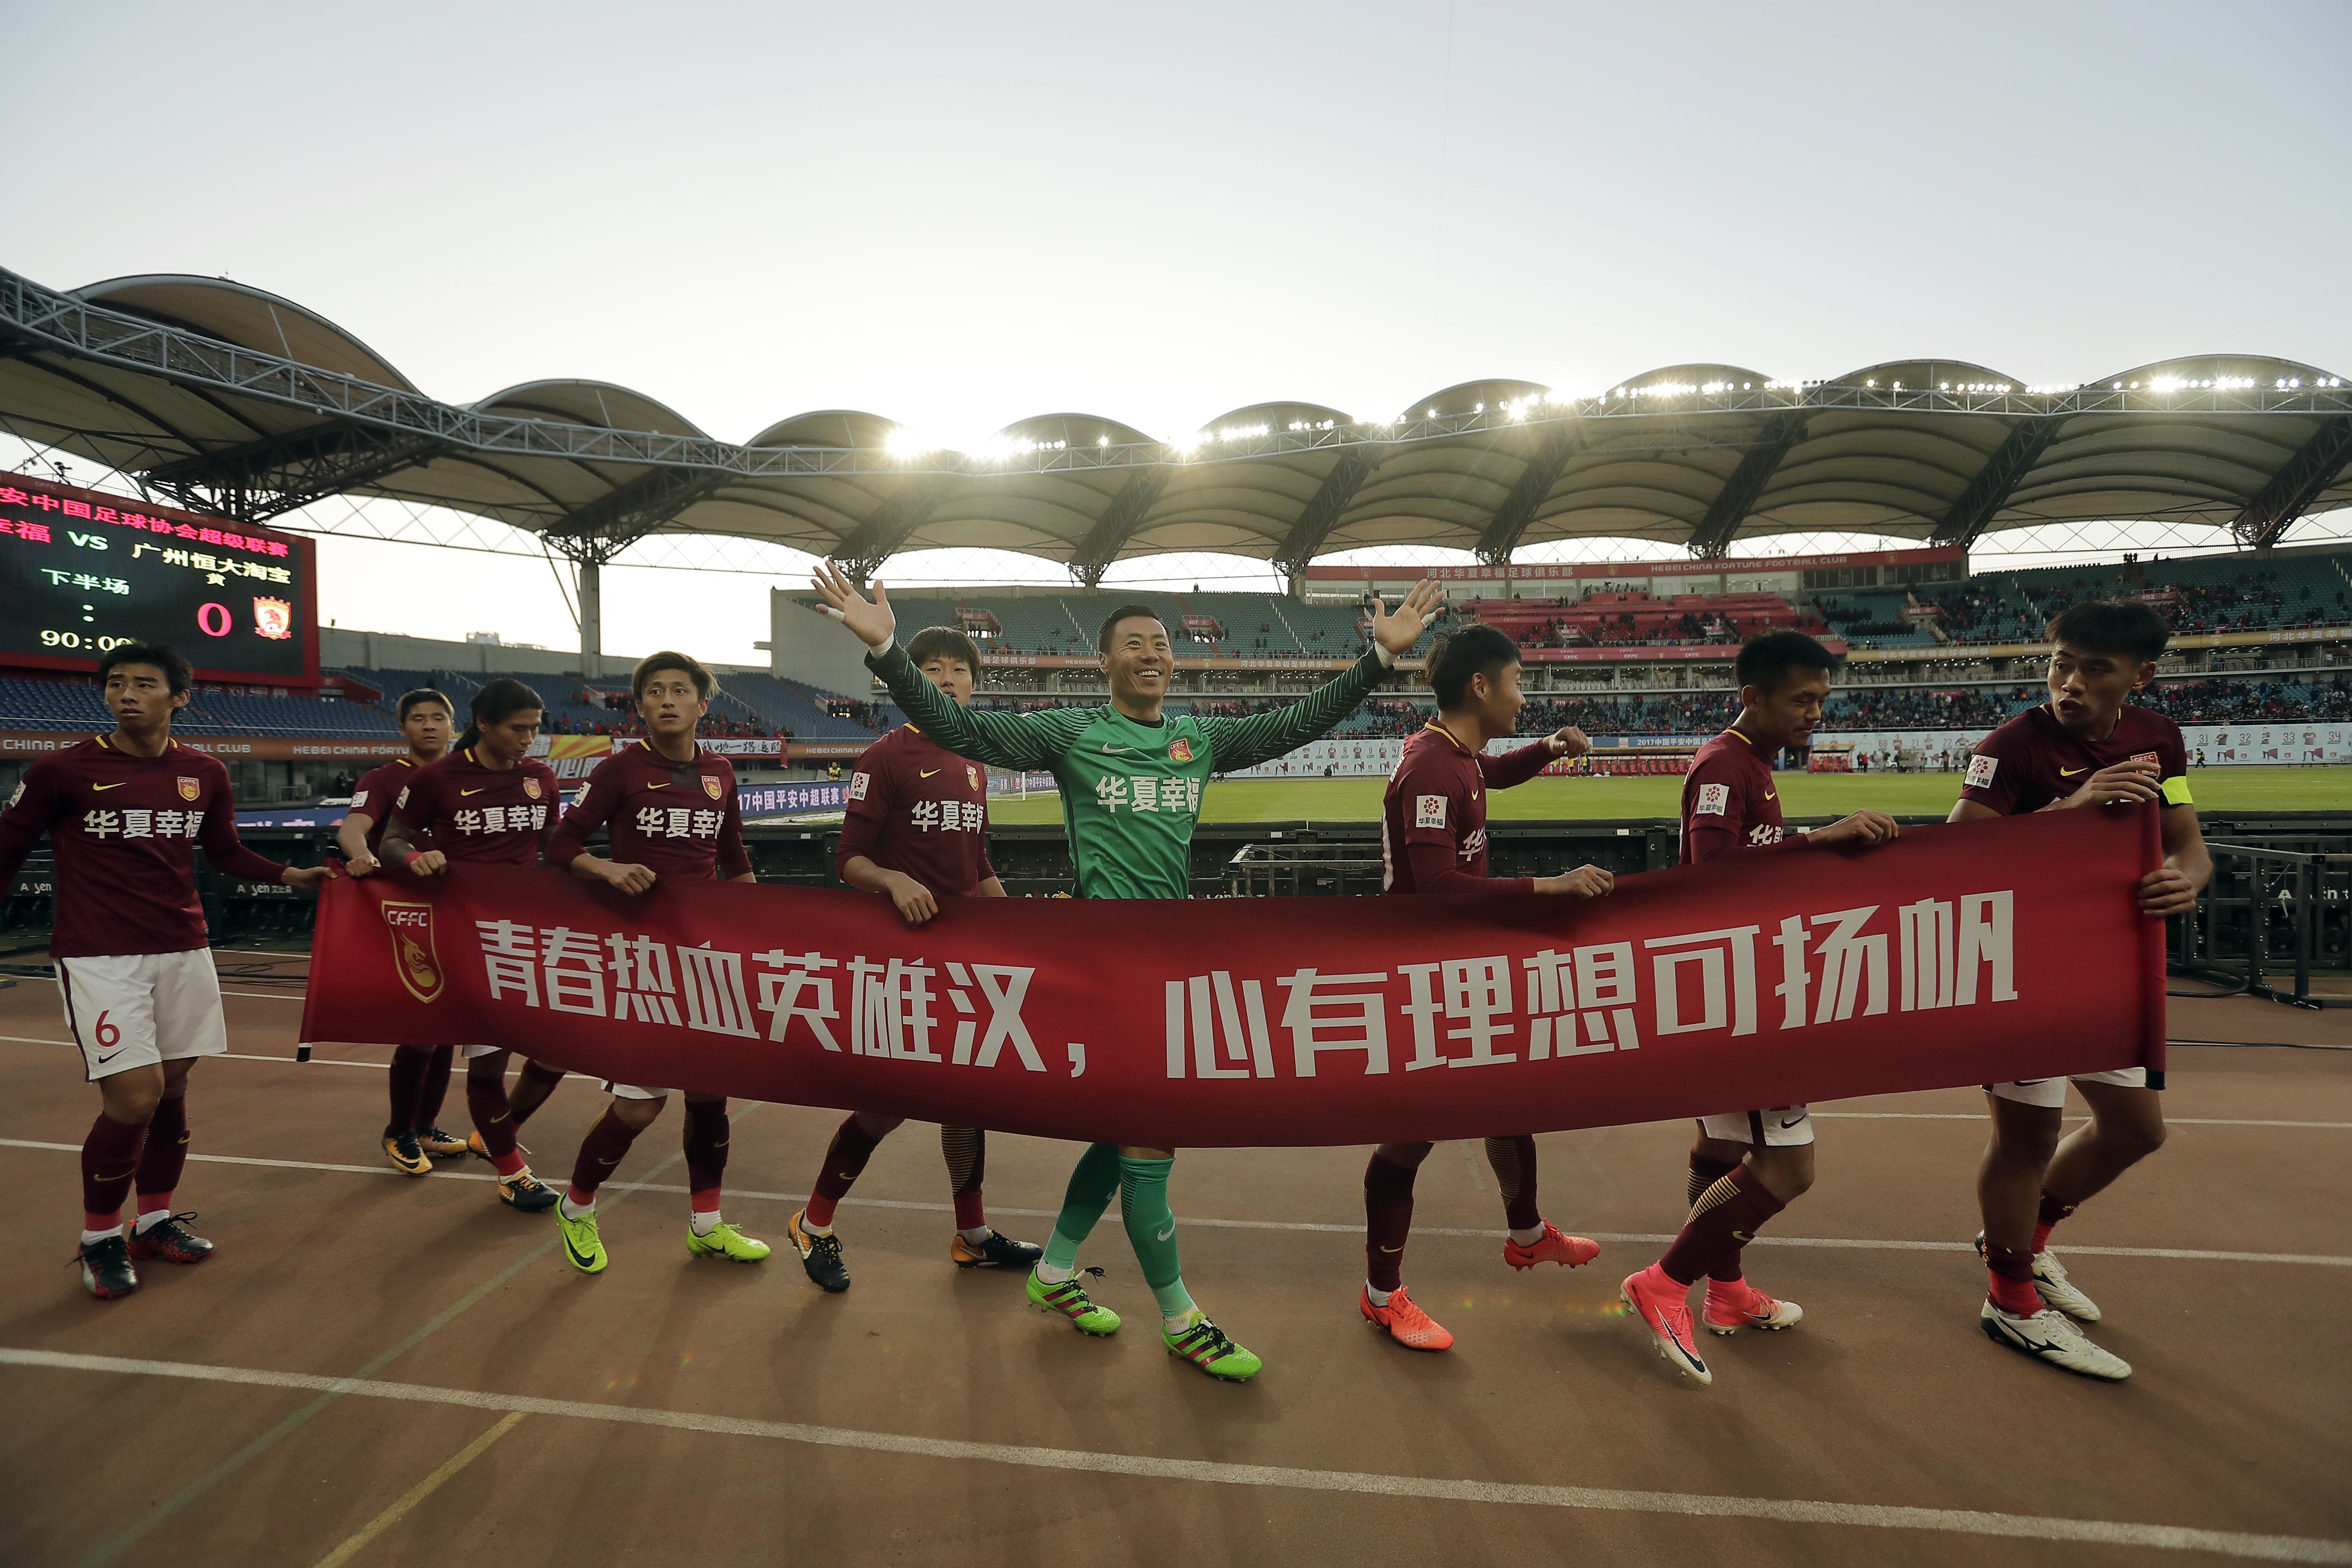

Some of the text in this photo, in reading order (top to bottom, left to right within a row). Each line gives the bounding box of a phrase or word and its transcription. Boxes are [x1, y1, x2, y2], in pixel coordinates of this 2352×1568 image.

[0, 487, 289, 557] 安中国足球协会超级联赛
[67, 530, 108, 550] VS
[131, 542, 291, 584] 广州恒大淘宝
[1765, 558, 1818, 567] FOOTBALL
[1427, 567, 1574, 578] 河北华夏幸福足球俱乐部
[40, 568, 130, 595] 下半场
[197, 602, 232, 637] 0
[2199, 734, 2208, 743] 31
[2239, 733, 2251, 742] 32
[2283, 732, 2295, 741] 33
[2328, 732, 2341, 741] 34
[3, 739, 55, 750] CHINA
[217, 744, 252, 753] CLUB
[293, 746, 331, 754] HEBEI
[333, 746, 368, 754] CHINA
[1170, 741, 1185, 750] CFFC
[1318, 747, 1322, 755] 7
[1095, 775, 1200, 813] 华夏幸福
[83, 809, 205, 839] 华夏幸福
[453, 805, 547, 836] 华夏幸福
[1418, 817, 1444, 826] 华夏幸福
[388, 910, 428, 927] CFFC
[1165, 890, 2018, 1078] 心有理想可扬帆
[95, 1010, 120, 1047] 6
